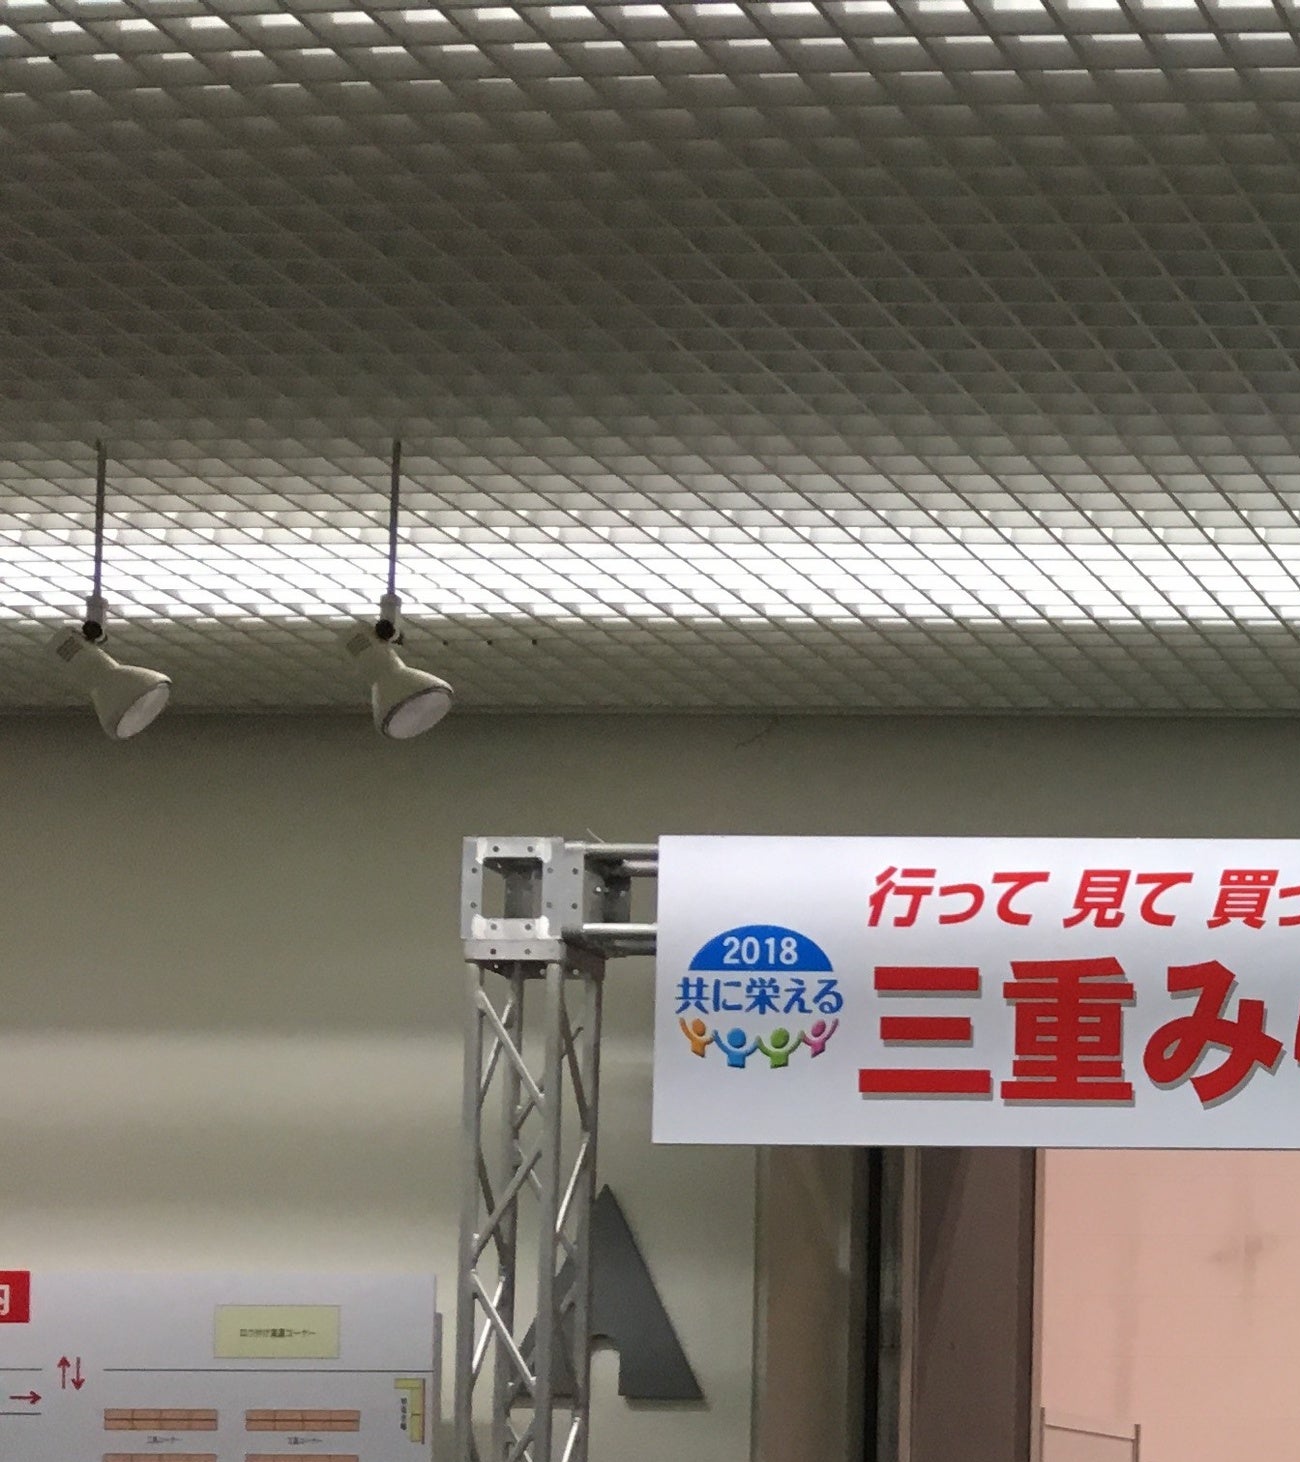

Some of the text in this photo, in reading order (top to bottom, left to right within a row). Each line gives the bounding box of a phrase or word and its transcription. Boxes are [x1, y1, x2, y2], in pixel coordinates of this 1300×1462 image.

[866, 867, 1051, 929] 行って
[1063, 869, 1194, 928] 見て
[722, 936, 799, 965] 2018
[676, 976, 844, 1015] 共に栄える
[512, 1184, 705, 1398] A
